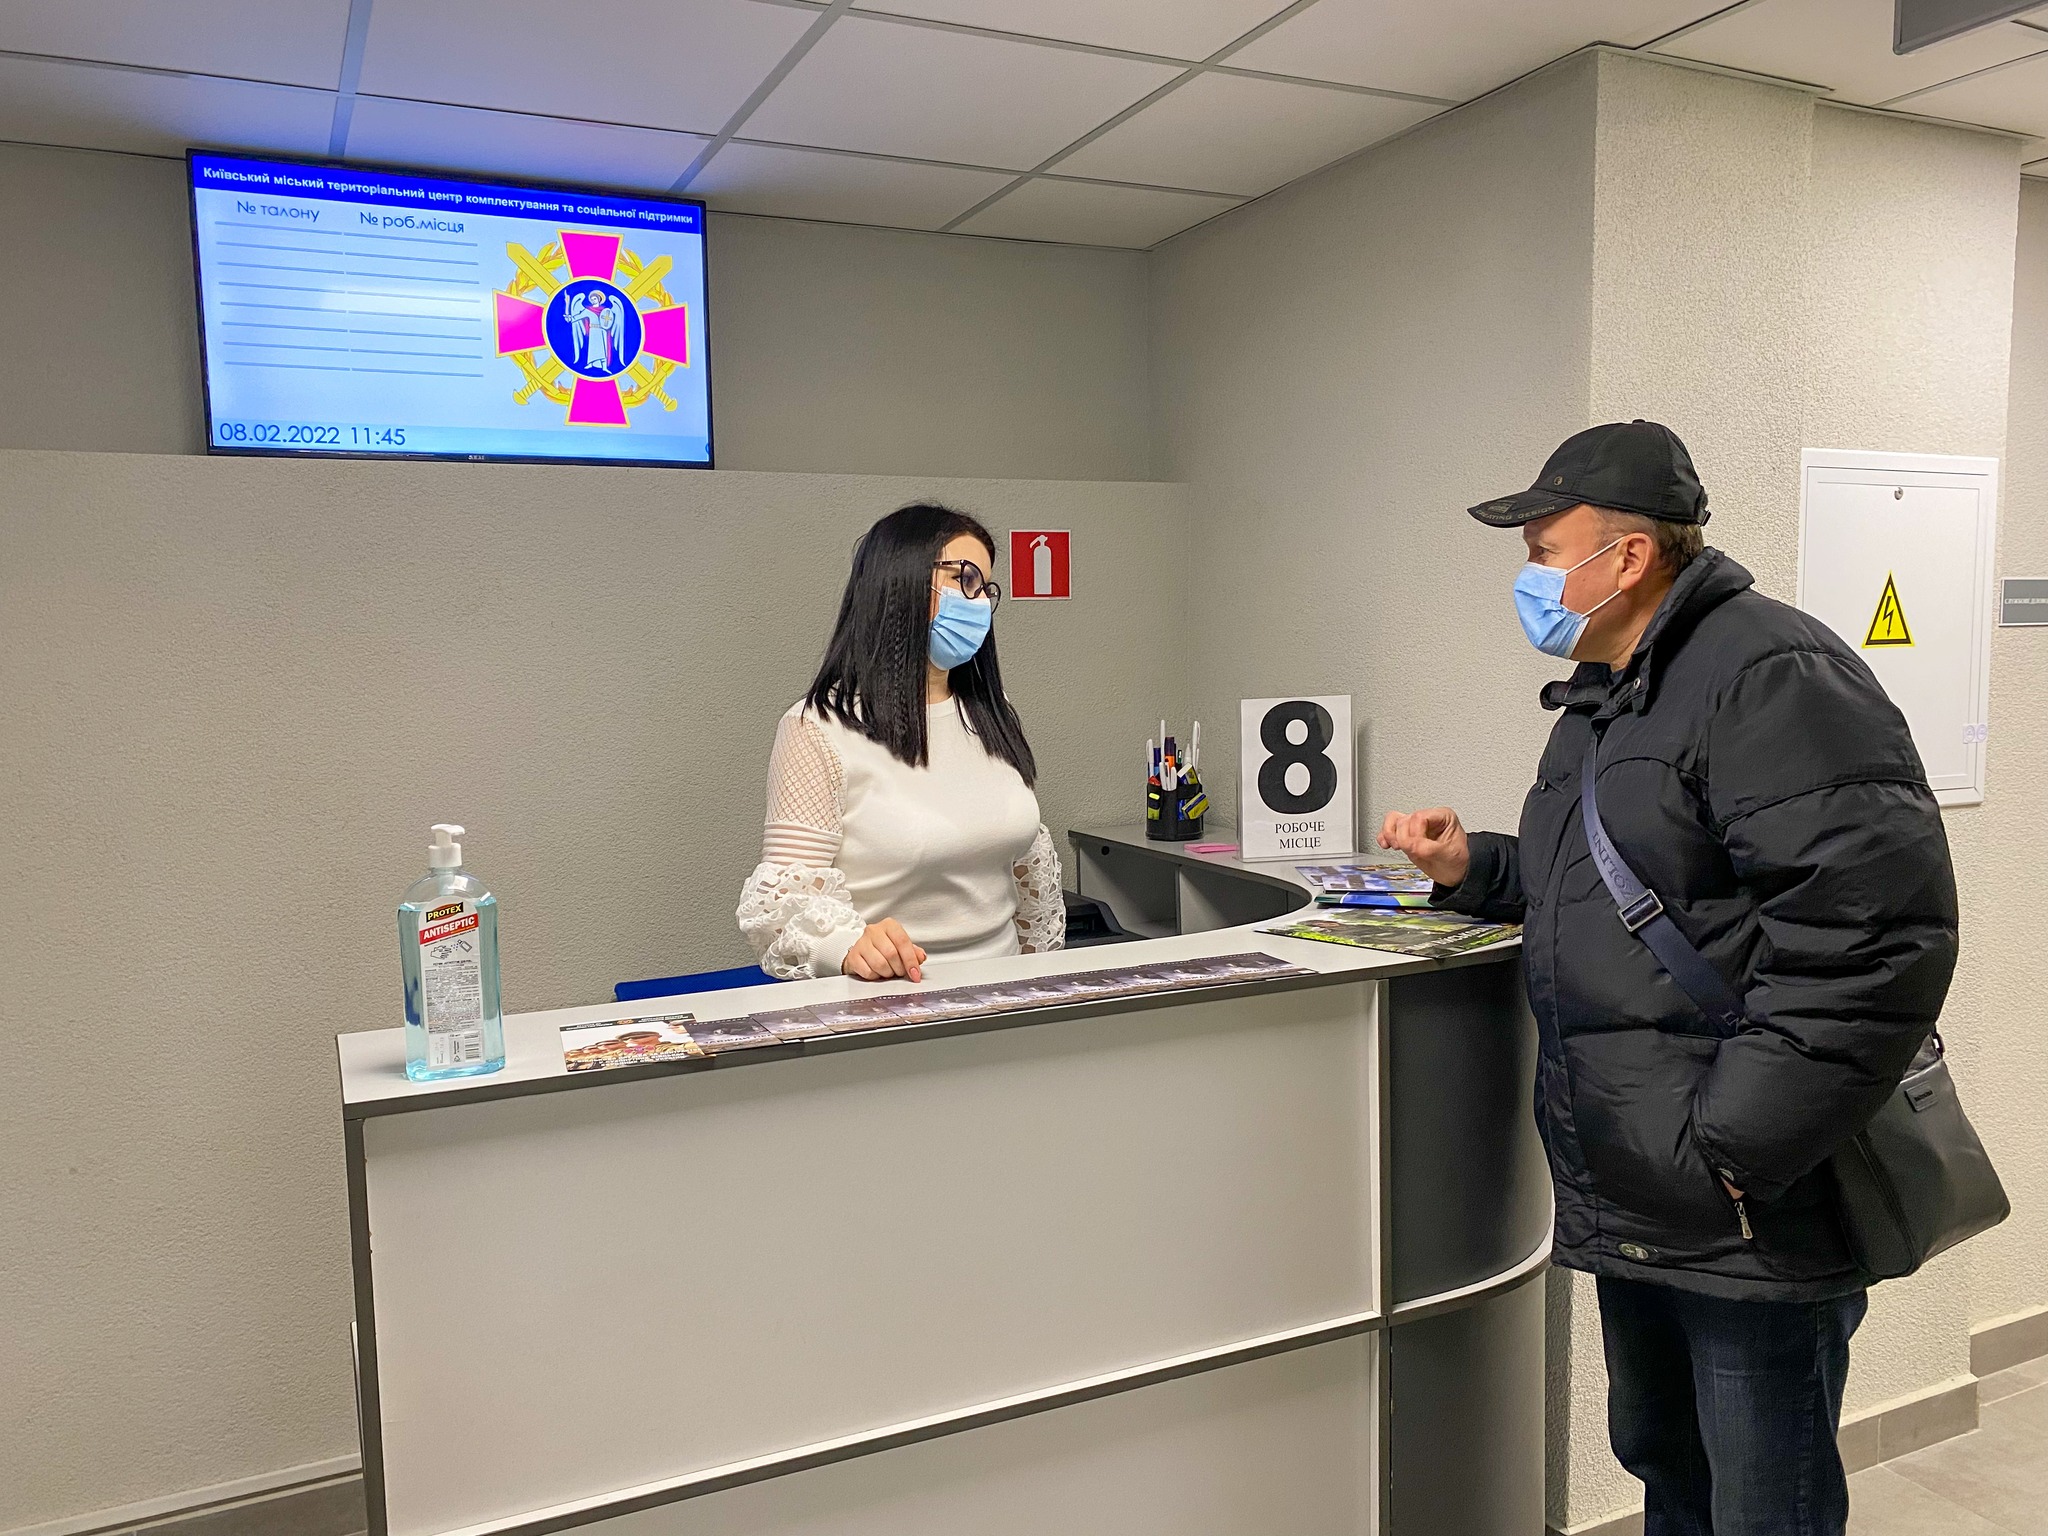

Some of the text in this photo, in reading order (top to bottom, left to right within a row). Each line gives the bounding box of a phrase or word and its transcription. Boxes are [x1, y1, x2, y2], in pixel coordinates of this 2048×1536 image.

[203, 167, 693, 225] Київський міський територіальний центр комплектування та соціальної підтримки
[237, 200, 320, 223] № талону
[360, 211, 464, 234] № роб.місця
[219, 422, 406, 446] 08.02.2022 11:45
[1257, 700, 1338, 815] 8
[1275, 821, 1325, 834] РОБОЧЕ
[1279, 837, 1321, 849] МІСЦЕ
[427, 903, 462, 921] PROTEX
[423, 916, 475, 940] ANTISEPTIC
